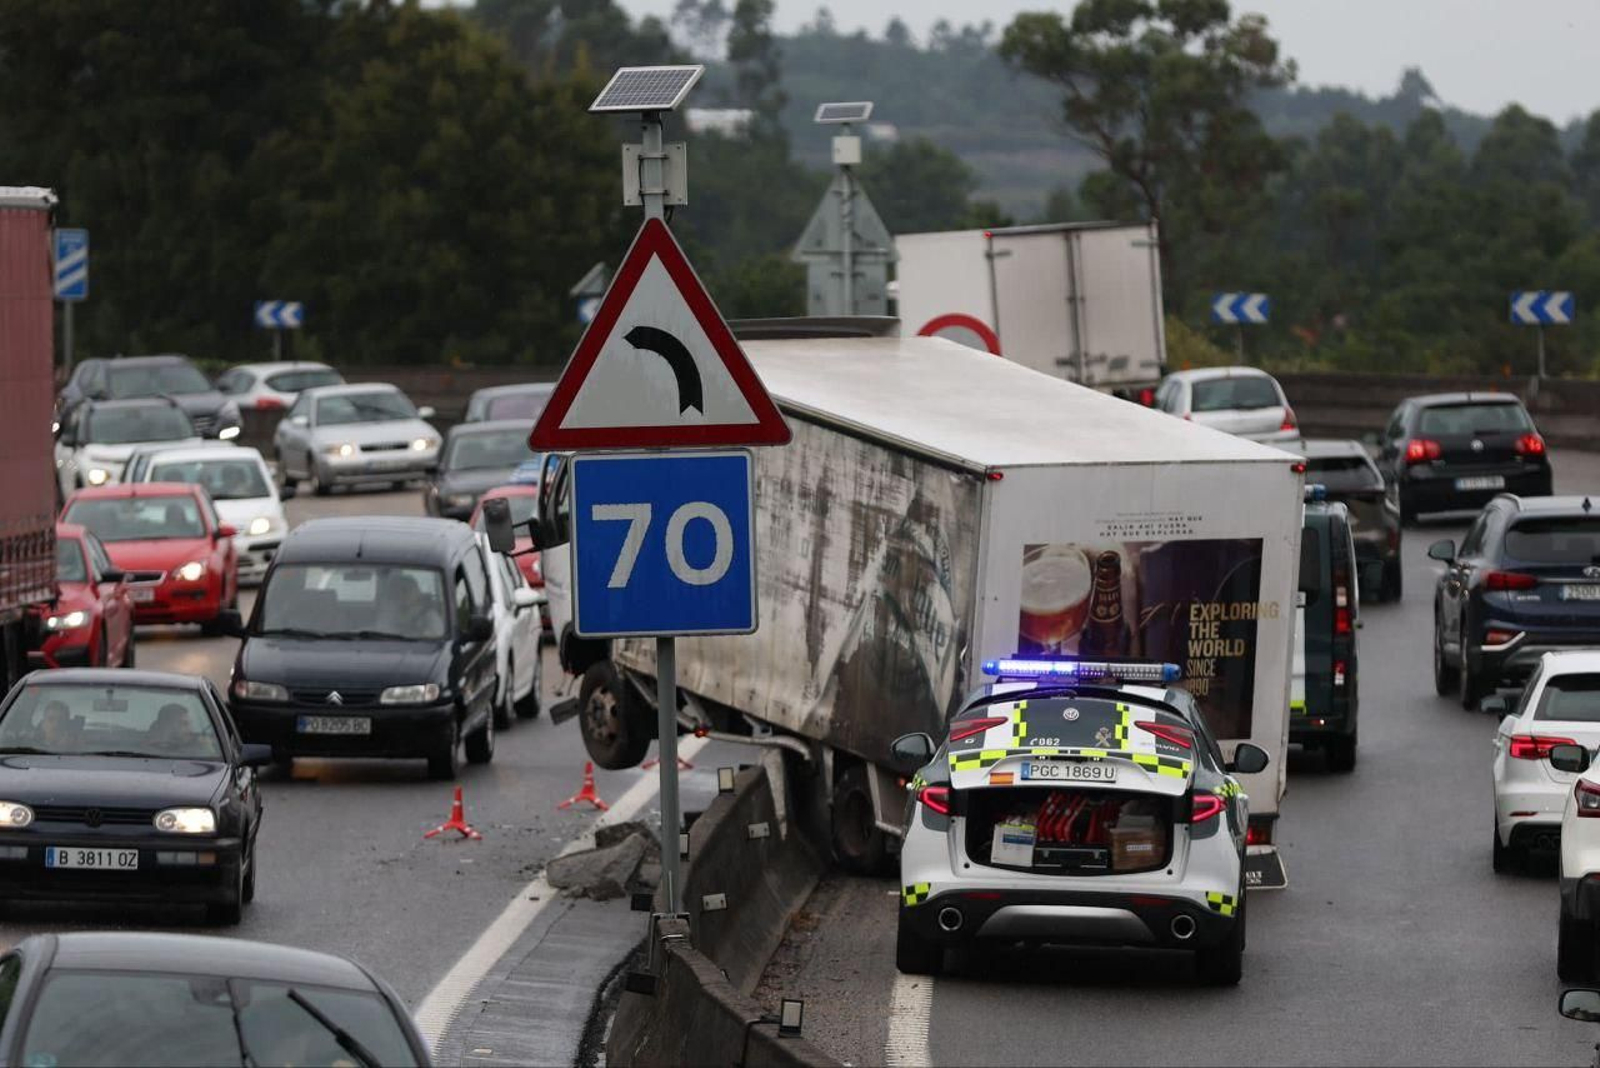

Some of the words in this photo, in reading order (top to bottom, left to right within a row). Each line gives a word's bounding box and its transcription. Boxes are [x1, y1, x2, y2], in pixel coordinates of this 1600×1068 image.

[592, 501, 734, 588] 70
[1190, 602, 1280, 620] EXPLORING
[1189, 622, 1220, 639] THE
[1188, 639, 1245, 657] WORLD
[1186, 659, 1217, 677] SINCE
[1039, 738, 1060, 746] 062
[1031, 765, 1059, 777] PGC
[1065, 766, 1101, 778] 1869
[1105, 768, 1115, 779] U
[60, 850, 68, 865] B
[77, 850, 112, 866] 3811
